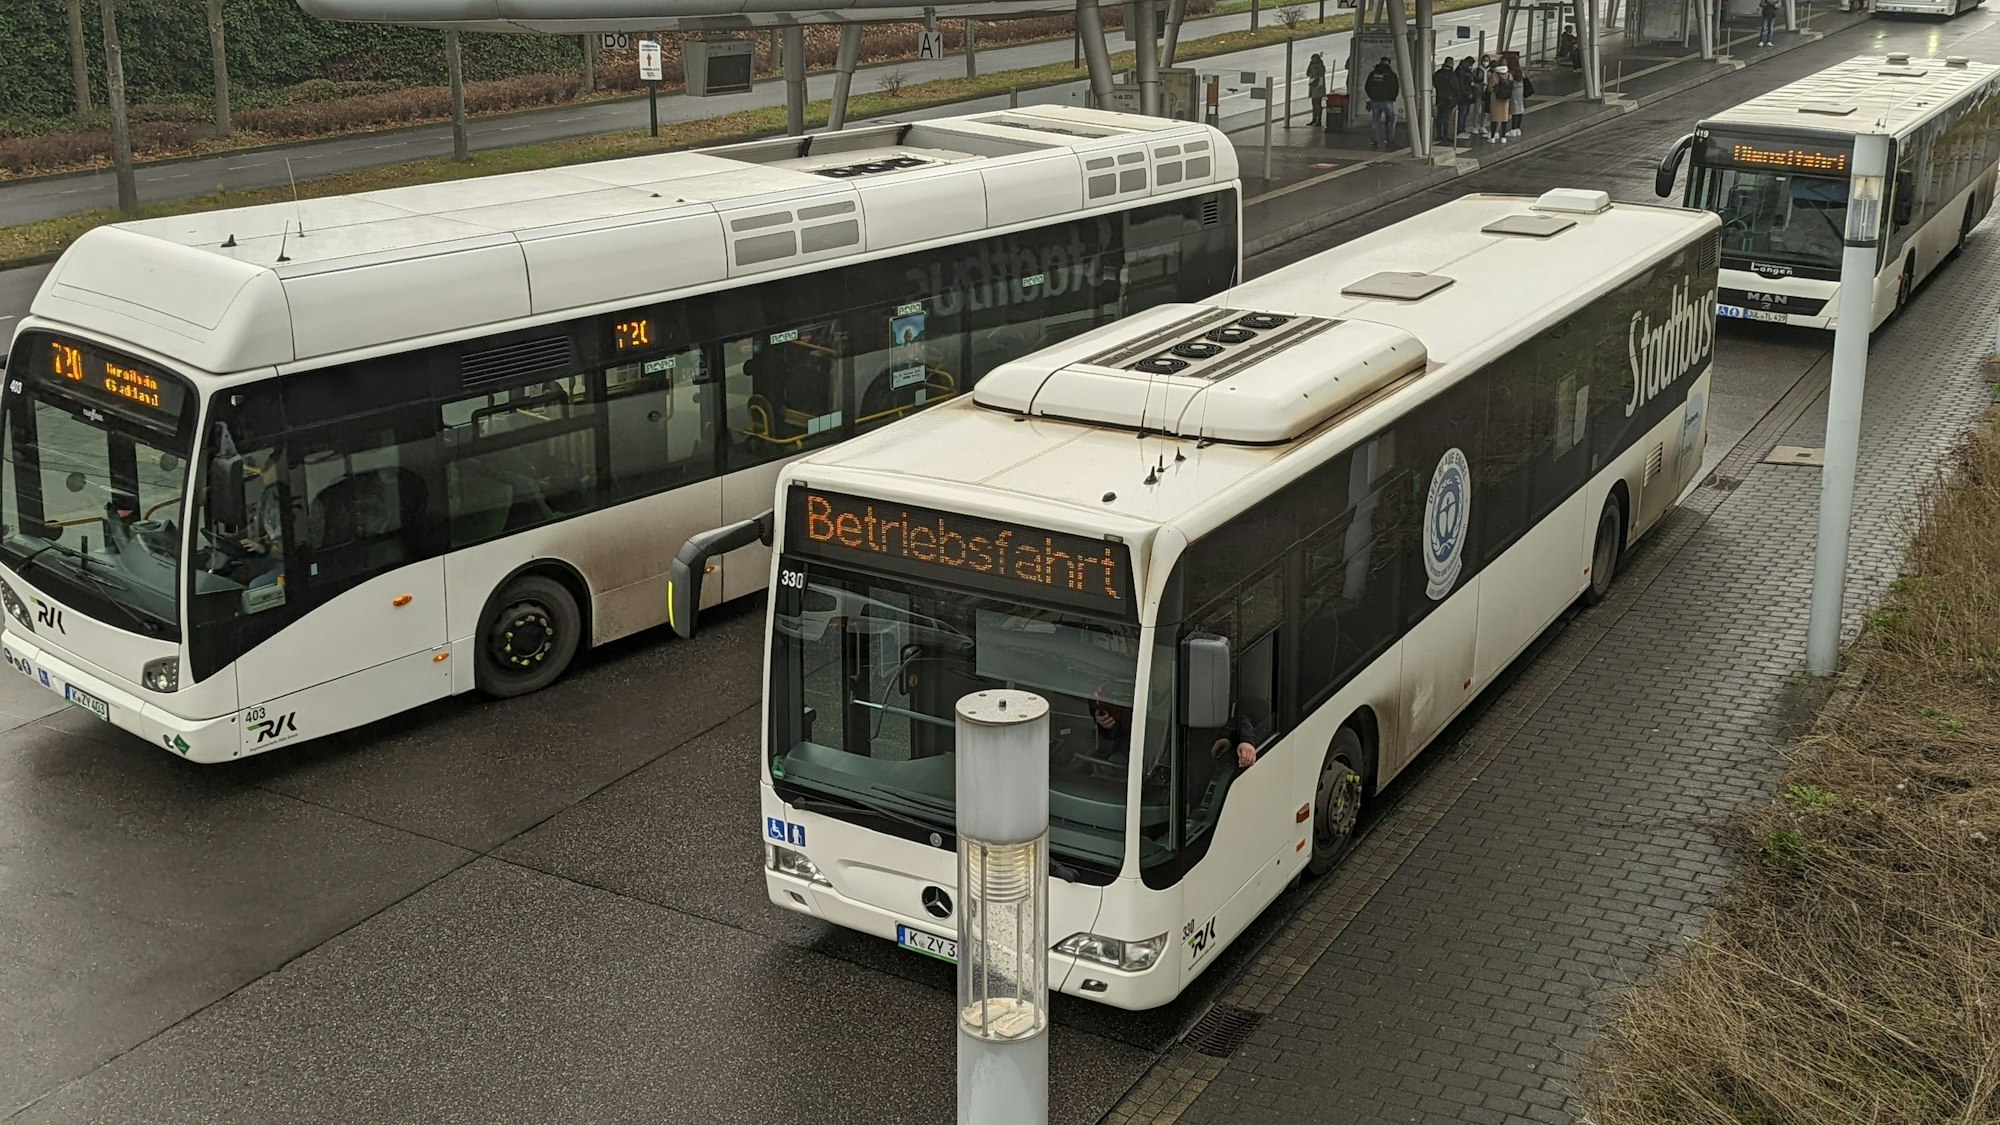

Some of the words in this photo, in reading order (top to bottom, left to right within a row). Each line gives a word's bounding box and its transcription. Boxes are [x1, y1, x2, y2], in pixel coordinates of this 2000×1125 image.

[921, 33, 943, 59] A1
[1750, 261, 1793, 275] Langen
[1747, 291, 1788, 304] MAN
[1625, 275, 1714, 418] Stadtbus
[9, 379, 22, 395] 403
[1429, 477, 1438, 504] DER
[807, 495, 1122, 600] Betriebsfahrt
[781, 569, 804, 589] 330
[72, 689, 77, 699] K
[81, 693, 91, 711] ZY
[92, 700, 105, 715] 403
[245, 707, 266, 722] 403
[1183, 918, 1194, 940] 330
[909, 931, 918, 946] K
[927, 936, 944, 953] ZY
[948, 943, 958, 957] 3
